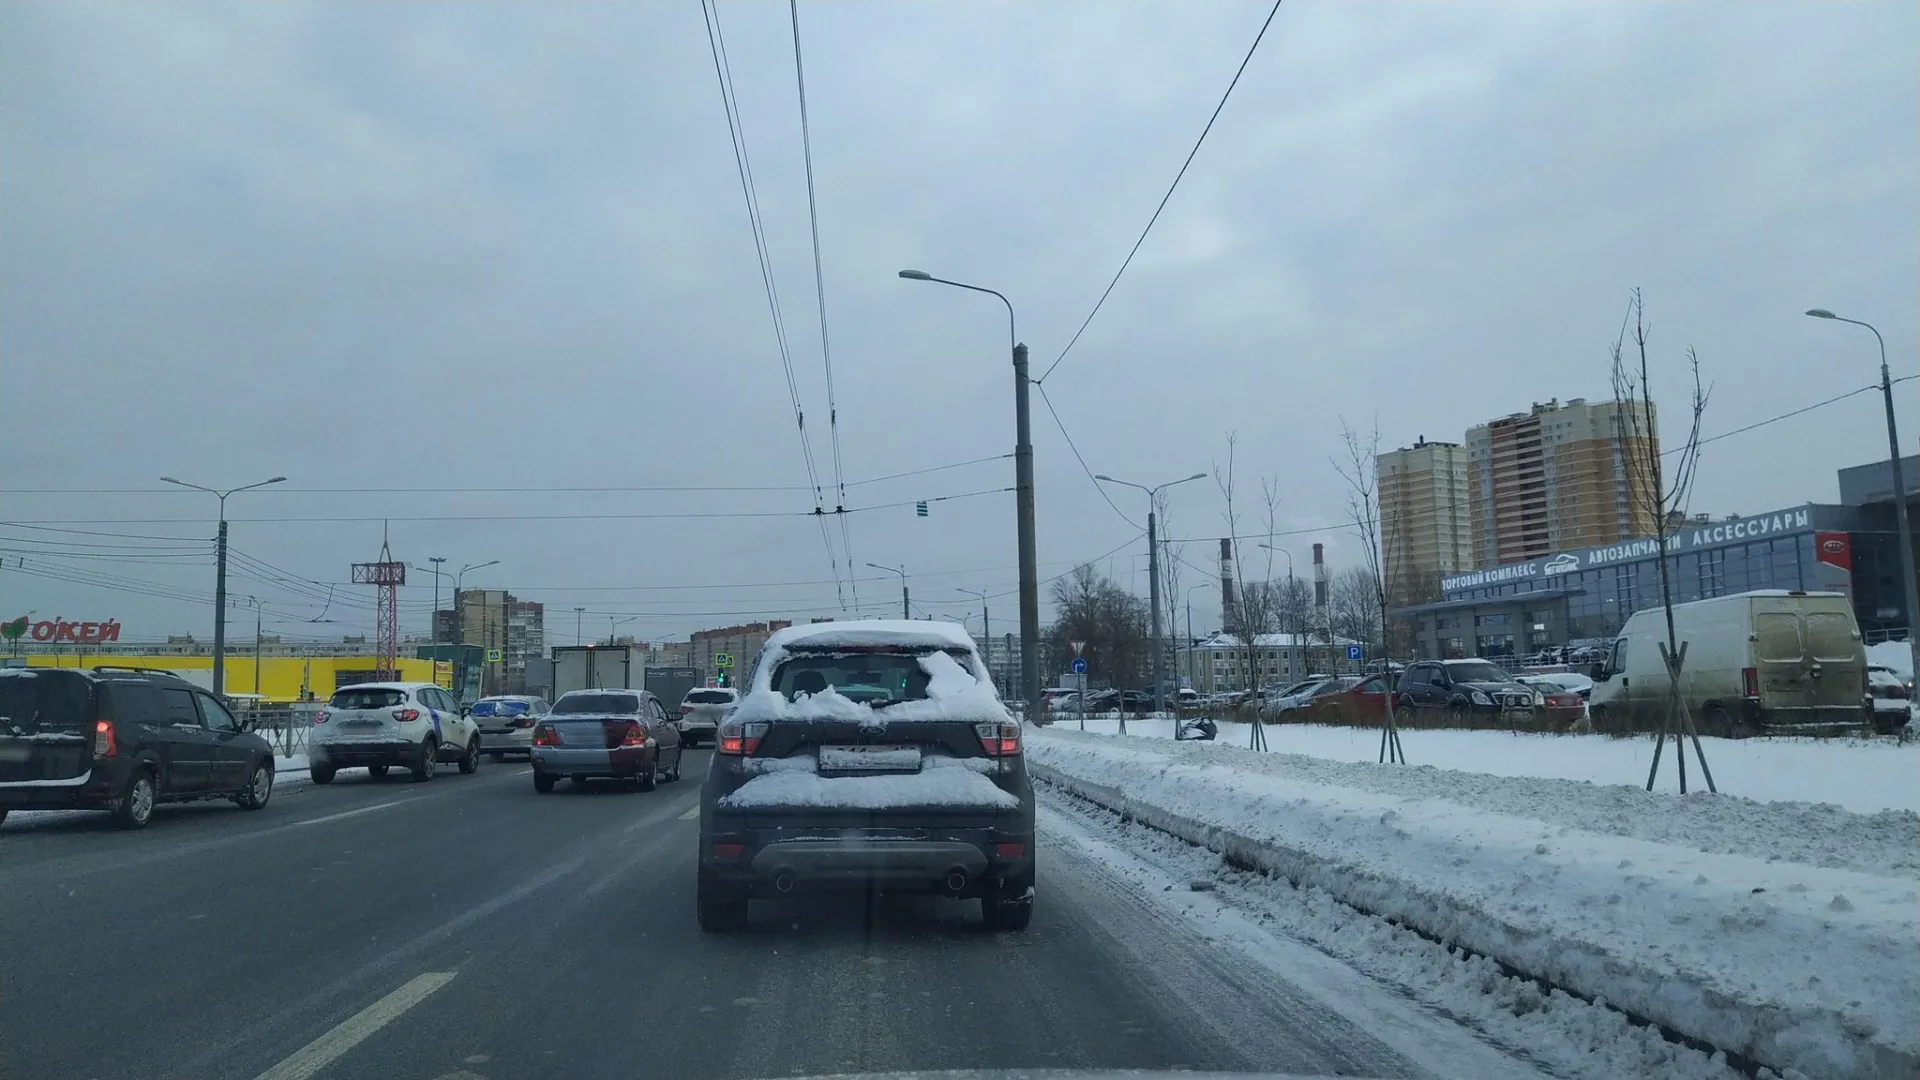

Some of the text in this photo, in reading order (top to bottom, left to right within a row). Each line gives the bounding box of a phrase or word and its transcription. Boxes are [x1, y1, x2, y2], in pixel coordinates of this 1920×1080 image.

[1692, 510, 1808, 546] АКСЕССУАРЫ
[1441, 563, 1537, 590] ТОРГОВЫЙ КОМПЛЕКС
